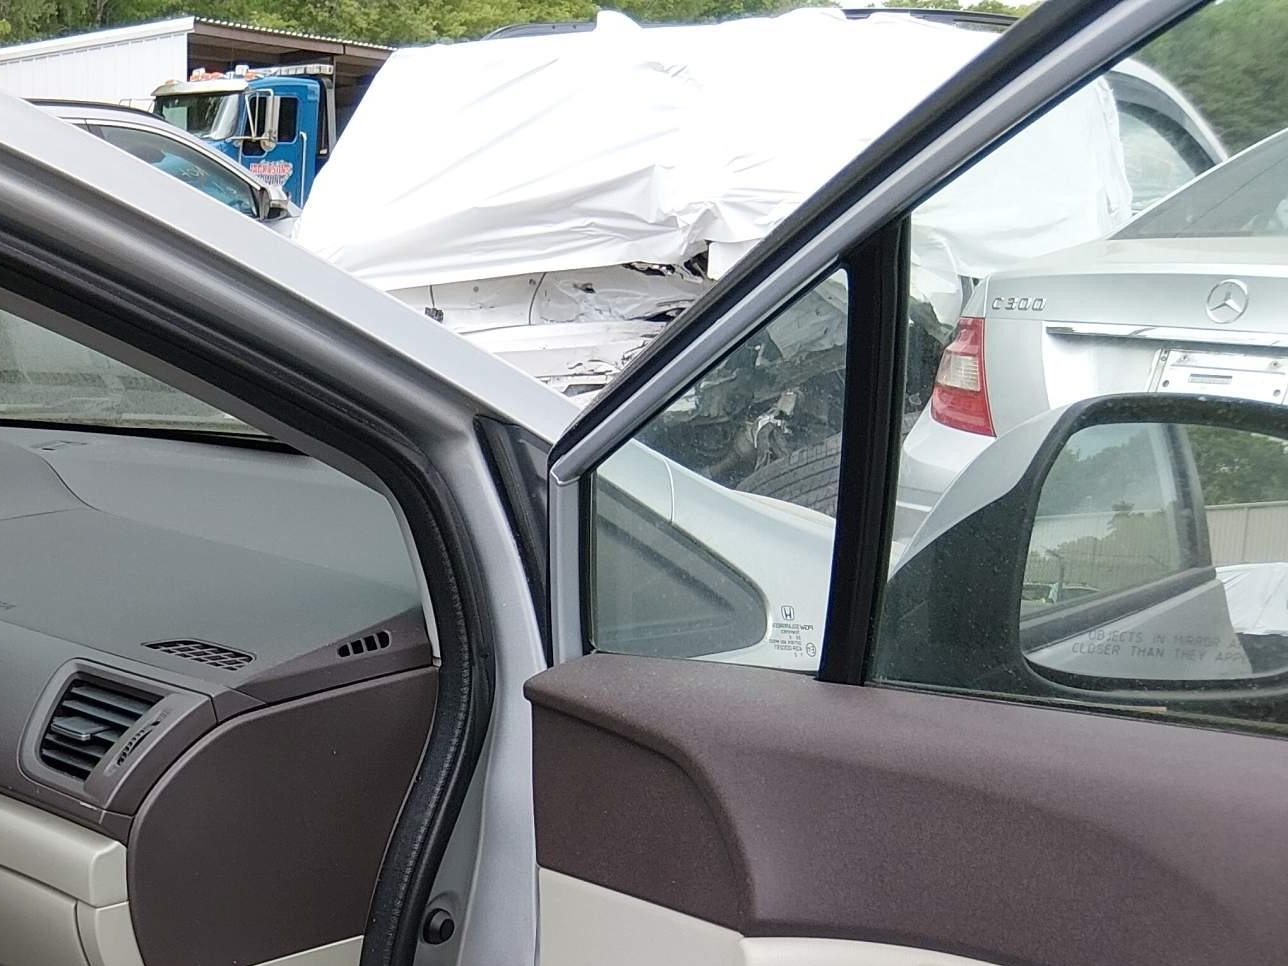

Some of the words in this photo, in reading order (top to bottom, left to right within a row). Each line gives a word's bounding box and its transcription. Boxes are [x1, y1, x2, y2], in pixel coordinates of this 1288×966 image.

[1088, 630, 1144, 643] OBJECTS
[1153, 633, 1165, 645] IN
[1072, 643, 1121, 656] CLOSER
[1130, 645, 1165, 659] THAN
